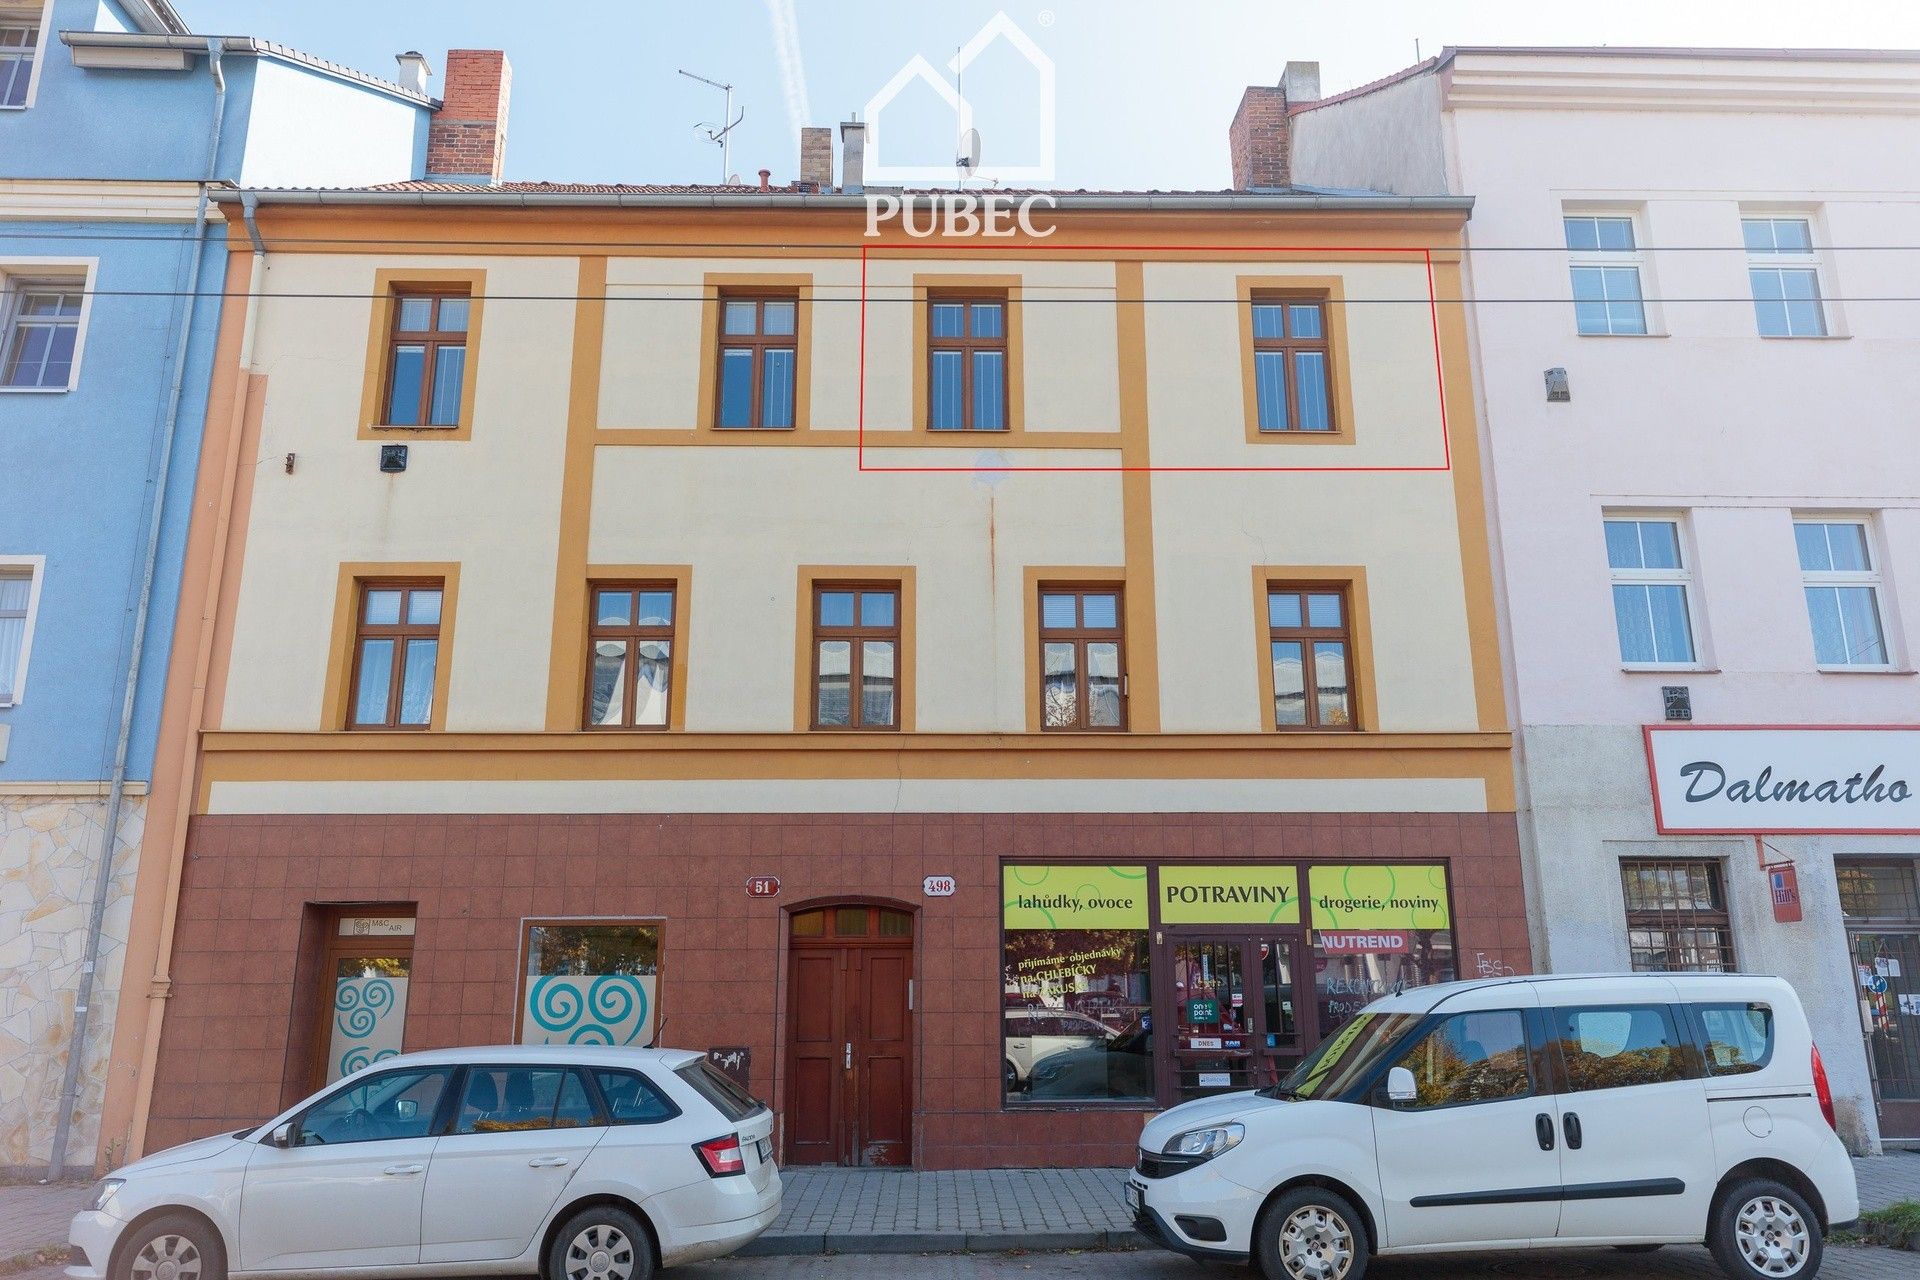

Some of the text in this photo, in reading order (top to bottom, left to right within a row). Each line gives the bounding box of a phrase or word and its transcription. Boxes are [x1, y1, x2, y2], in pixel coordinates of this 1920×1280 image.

[1679, 761, 1912, 804] Dalmatho
[755, 880, 770, 894] 51
[928, 880, 951, 893] 498
[1166, 886, 1290, 903] POTRAVINY
[1018, 894, 1133, 912] lahůdky, ovoce
[1319, 894, 1439, 913] drogerie, noviny
[1774, 888, 1797, 903] Hill's
[1321, 934, 1403, 949] NUTREND
[1018, 947, 1122, 971] přijímáme objednávky
[1036, 964, 1097, 981] CHLEBÍČKY
